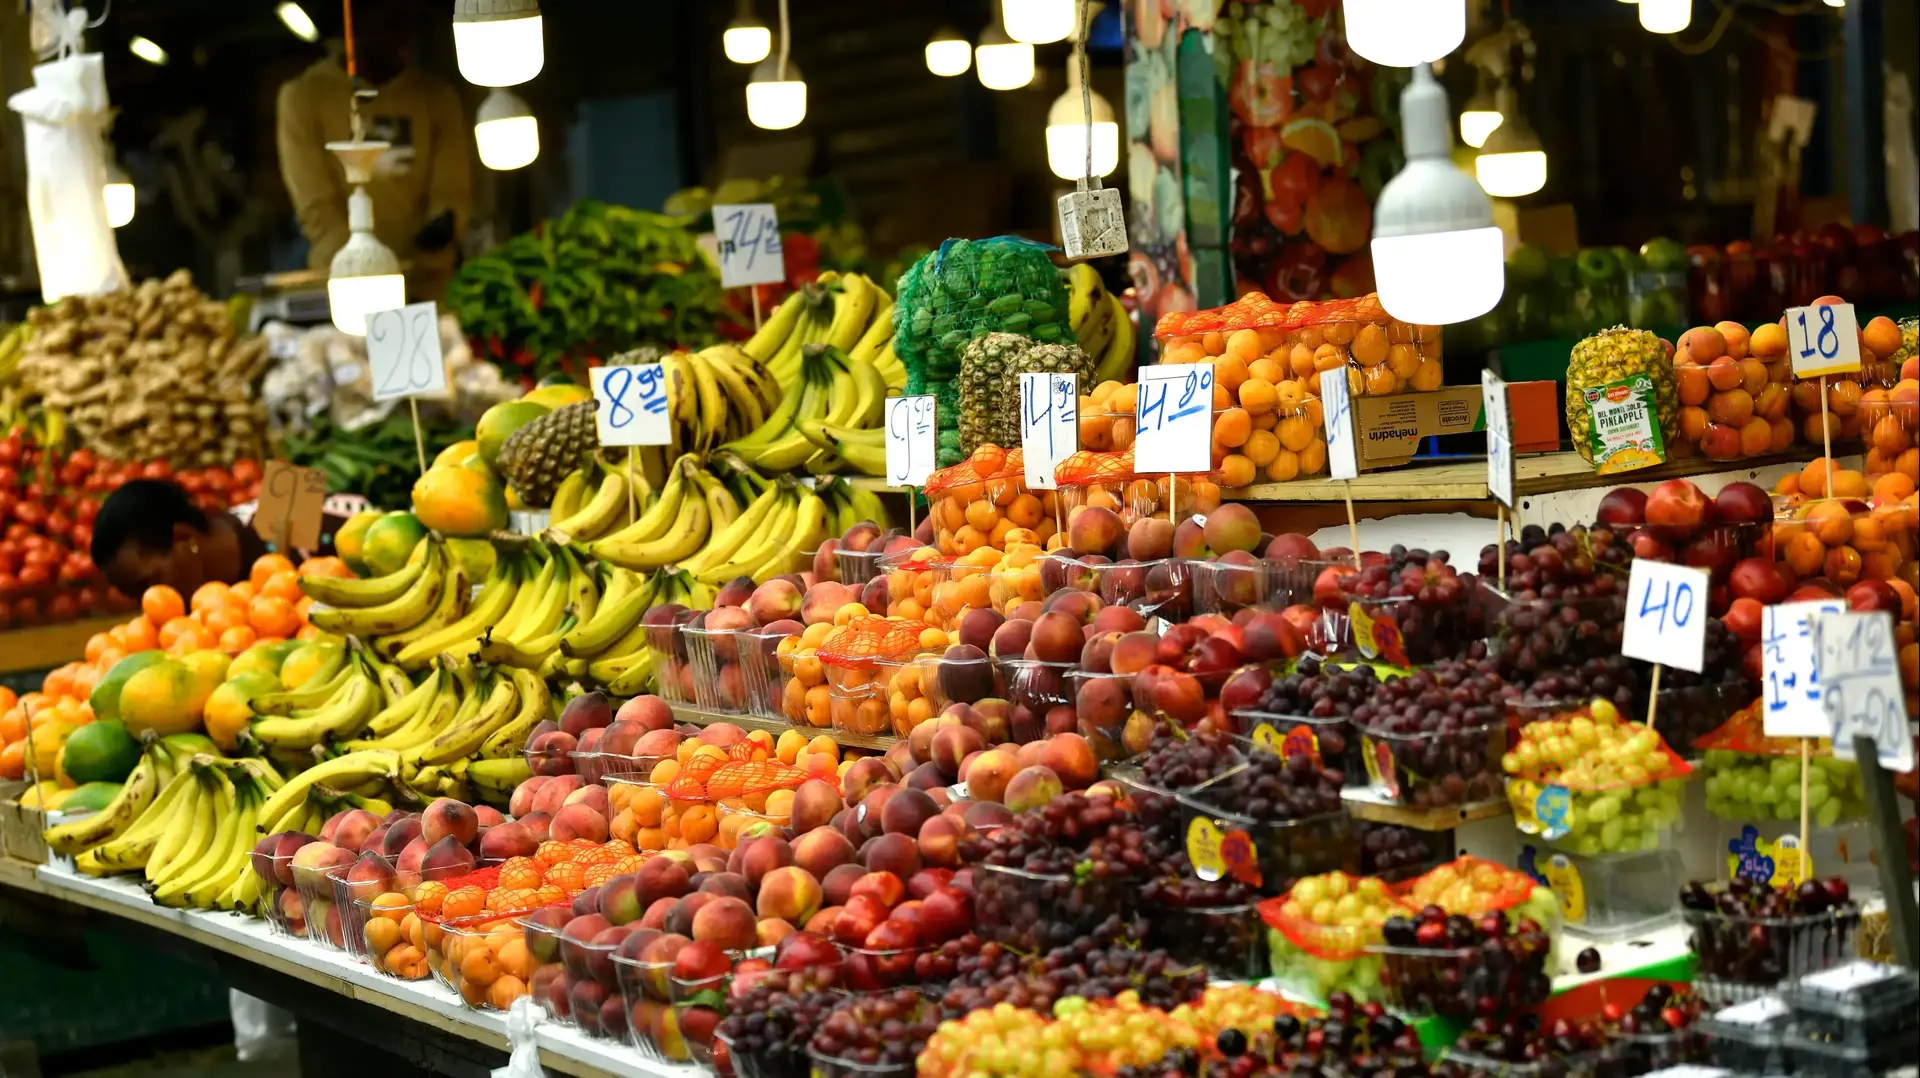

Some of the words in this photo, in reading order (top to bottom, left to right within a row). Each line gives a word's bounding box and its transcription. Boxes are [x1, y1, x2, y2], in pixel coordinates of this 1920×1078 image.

[371, 309, 434, 395] 28
[1797, 305, 1839, 359] 18
[1368, 427, 1419, 443] mehadrin
[1600, 409, 1644, 429] PINEAPPLE
[1639, 577, 1693, 635] 40
